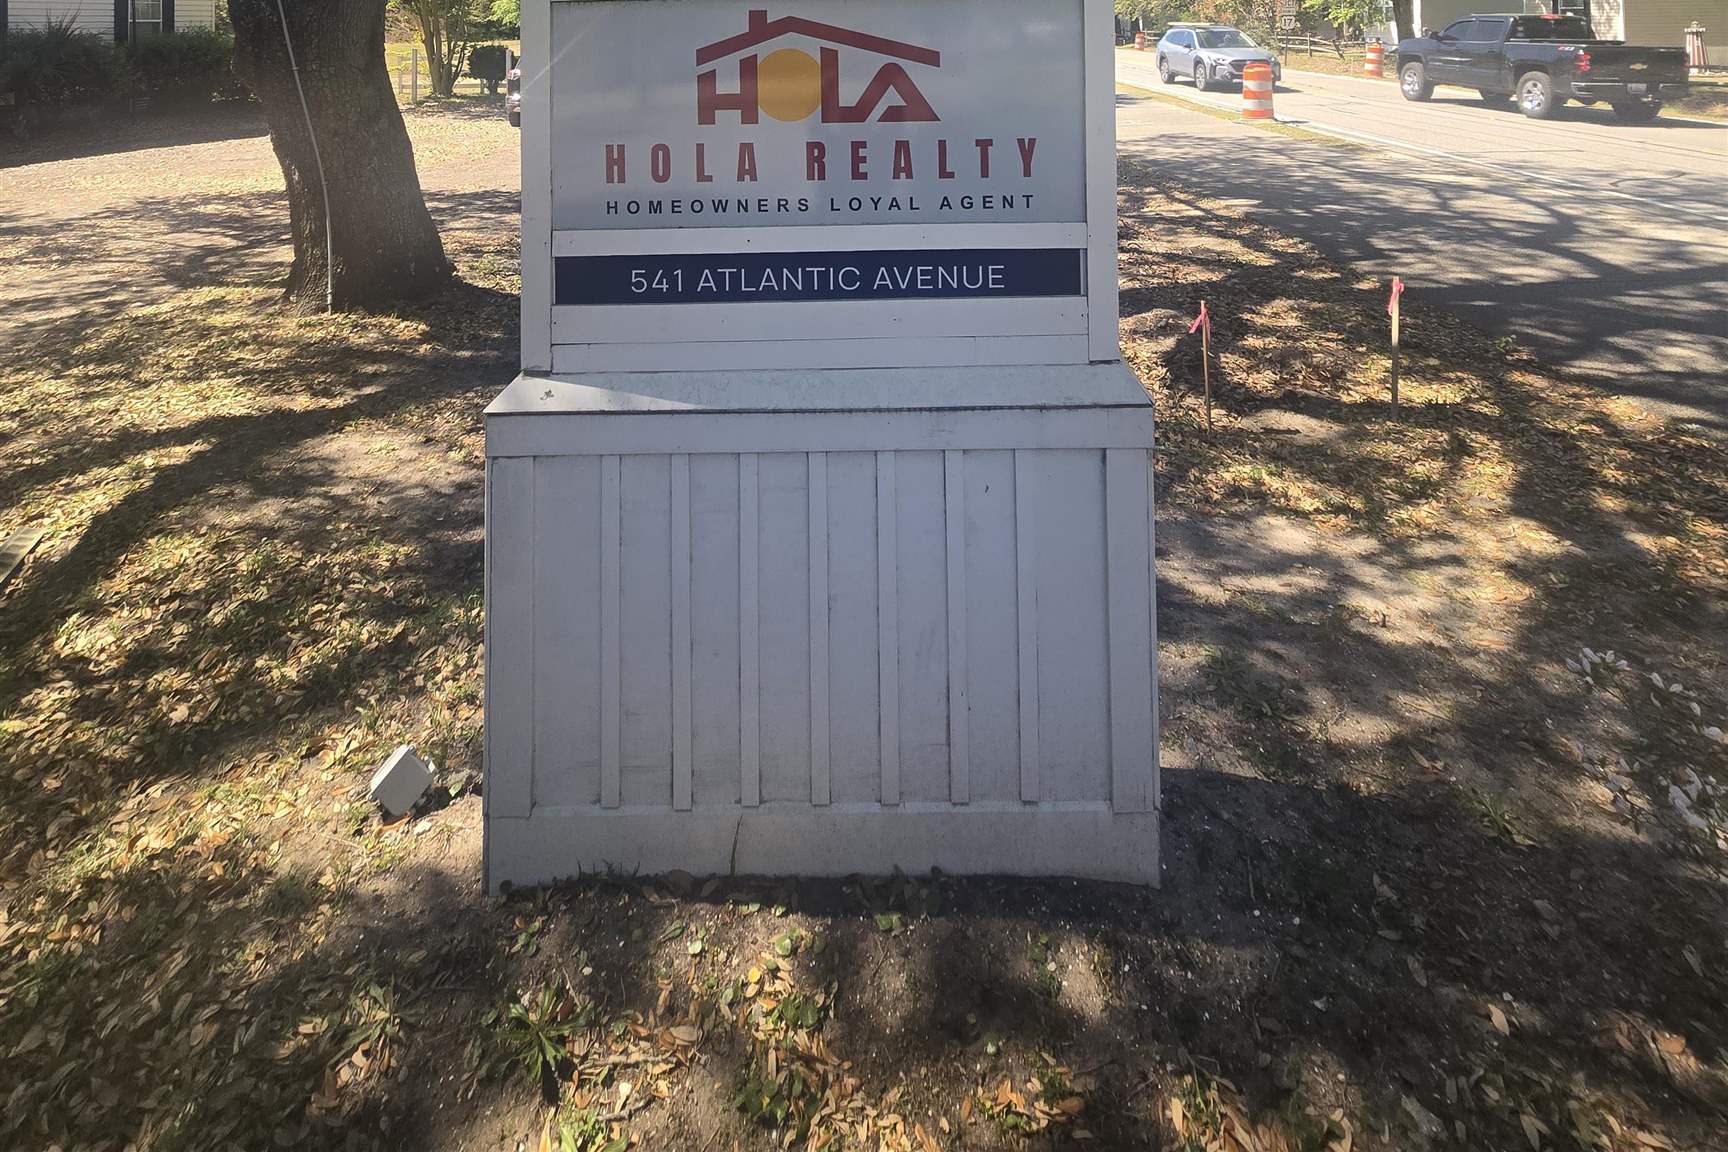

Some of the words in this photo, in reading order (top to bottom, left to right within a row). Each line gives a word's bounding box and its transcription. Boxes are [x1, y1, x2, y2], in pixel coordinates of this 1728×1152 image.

[1283, 18, 1293, 27] 17
[605, 142, 759, 184] HOLA
[805, 137, 1037, 181] REALTY
[605, 197, 810, 215] HOMEOWNERS
[830, 195, 921, 212] LOYAL
[939, 194, 1035, 210] AGENT
[630, 269, 683, 293] 541
[697, 266, 861, 293] ATLANTIC
[872, 264, 1006, 290] AVENUE
